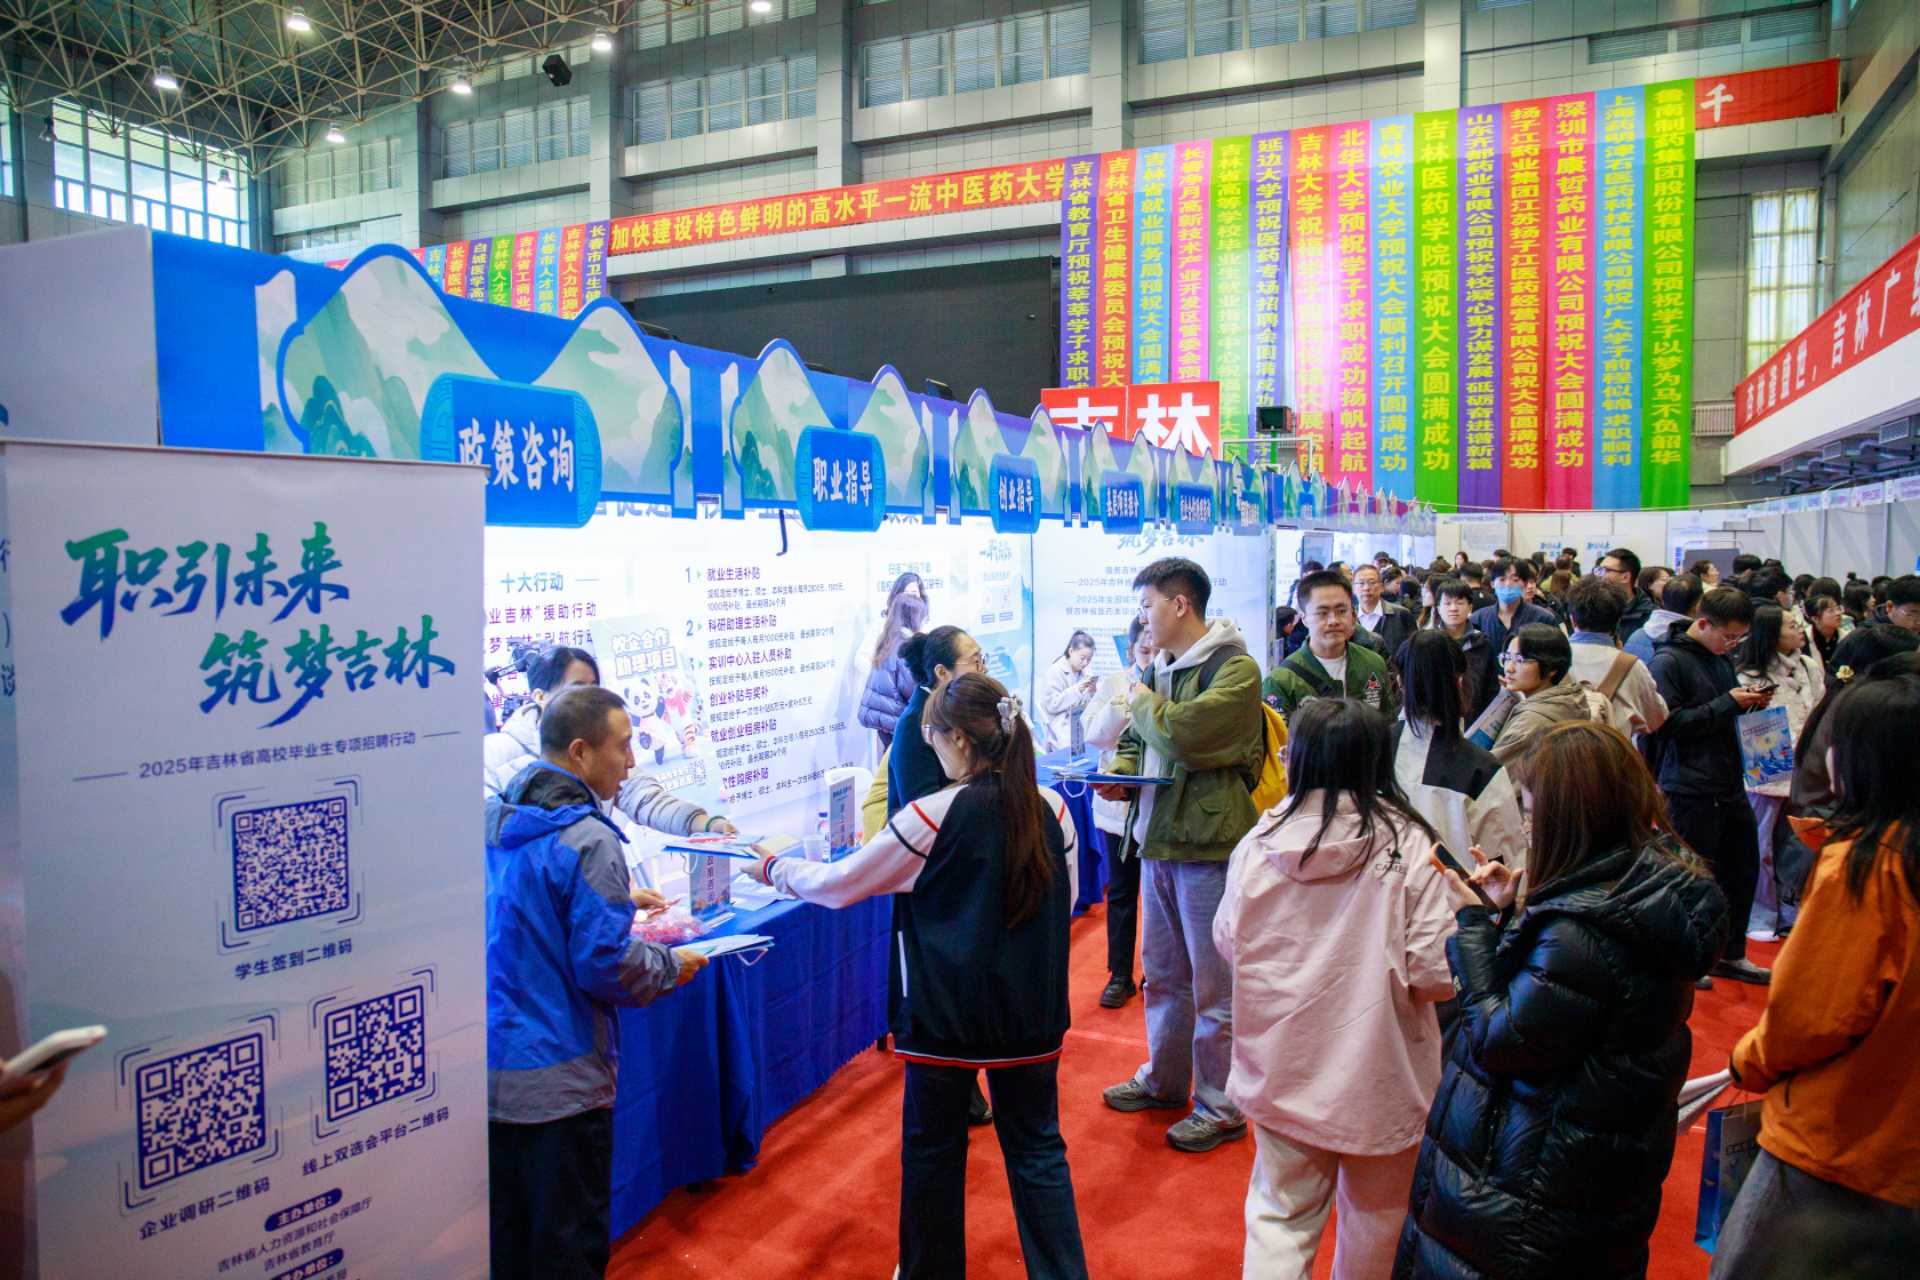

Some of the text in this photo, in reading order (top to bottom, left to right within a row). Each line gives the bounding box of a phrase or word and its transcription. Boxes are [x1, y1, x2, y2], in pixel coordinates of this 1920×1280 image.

[1699, 83, 1734, 122] 千
[611, 163, 1065, 250] 加快建设特色鲜明的高水平一流中医药大学
[1066, 160, 1093, 388] 吉林省教育厅预祝莘莘学子求职
[1137, 151, 1168, 384] 吉林省就业服务局预祝大会圆满
[1338, 128, 1368, 473] 北华大学预祝学子求职成功扬帆起航
[1378, 124, 1408, 472] 吉林农业大学预祝大会顺利召开圆满成功
[1421, 119, 1450, 471] 吉林医药学院预祝大会圆满成功
[1555, 101, 1587, 468] 深圳市康哲药业有限公司预祝大会圆满成功
[457, 419, 575, 492] 政策咨询
[1049, 392, 1212, 456] 吉林
[813, 456, 874, 505] 职业指导
[60, 521, 350, 641] 职引未来
[501, 571, 564, 594] 十大行动
[199, 614, 456, 729] 筑梦吉林
[139, 730, 417, 779] 2025年吉林省高校毕业生专项招聘行动
[235, 938, 353, 980] 学生签到二维码
[302, 1106, 450, 1177] 线上双选会平台二维码
[139, 1177, 271, 1241] 企业调研二维码
